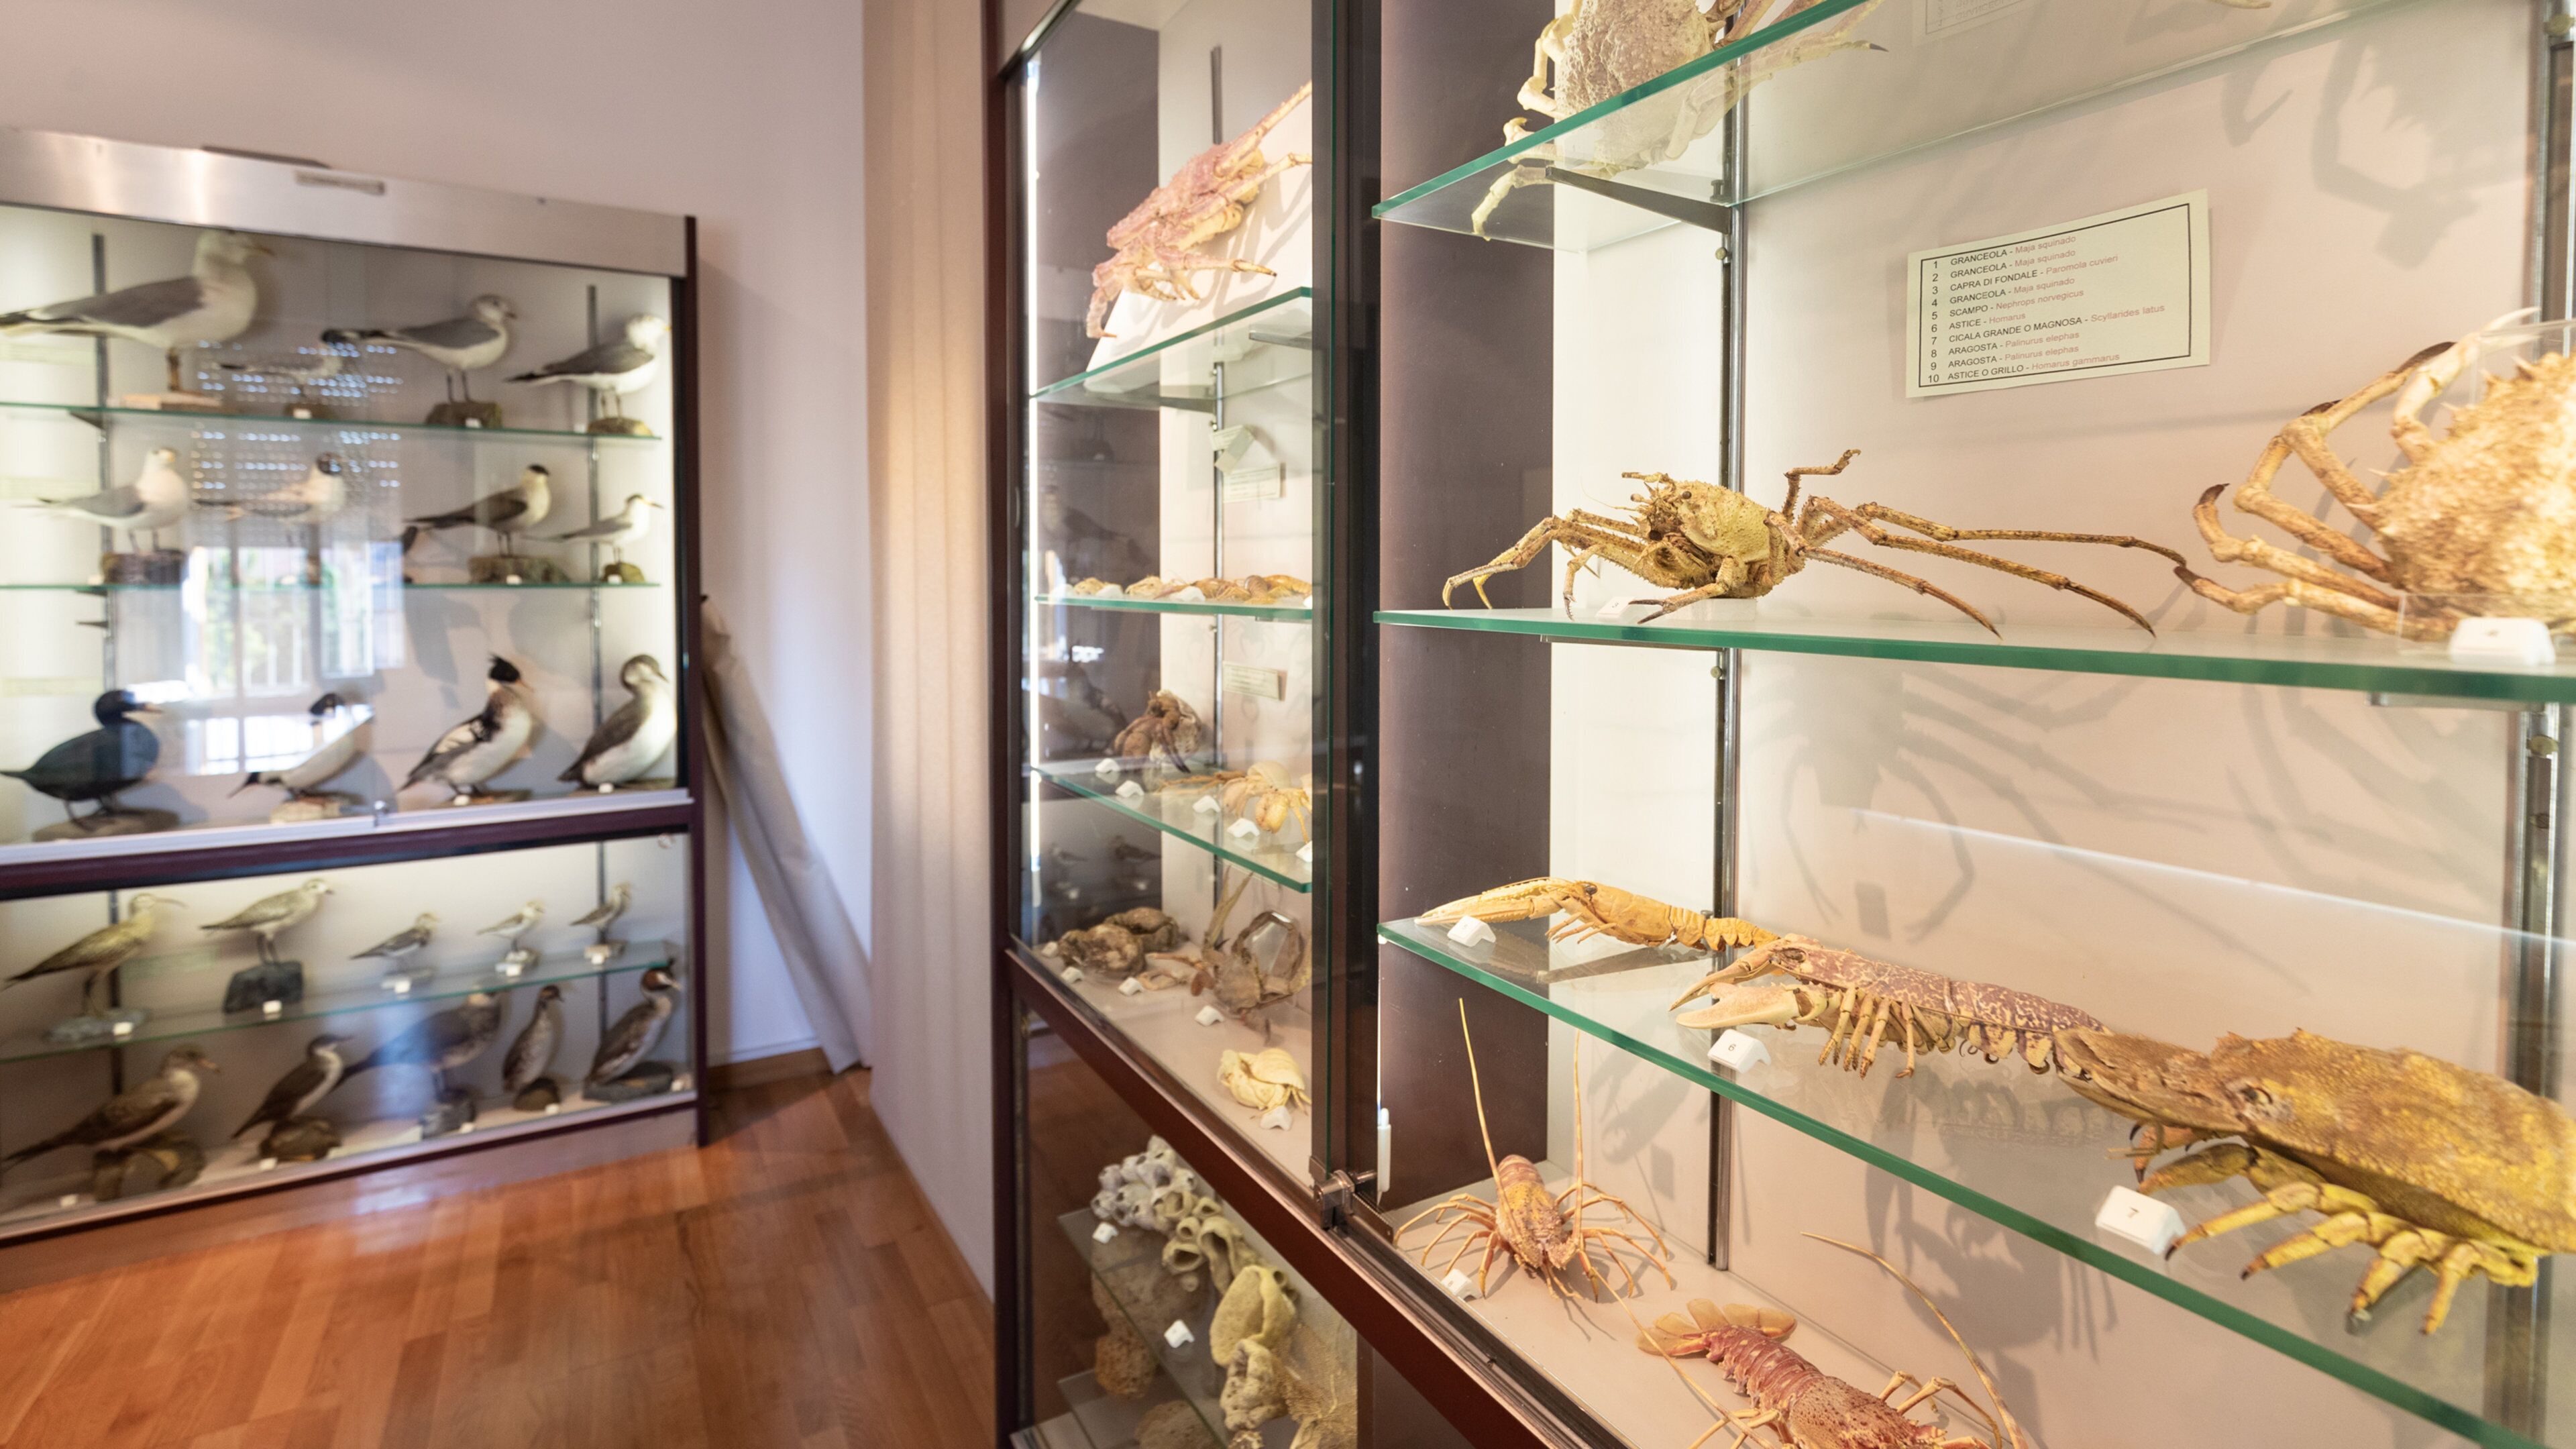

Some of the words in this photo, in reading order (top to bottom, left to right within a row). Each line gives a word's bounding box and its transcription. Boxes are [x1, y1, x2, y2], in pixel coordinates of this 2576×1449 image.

[1950, 250, 2007, 266] GRANCEOLA
[2015, 244, 2035, 254] Maja
[2038, 235, 2076, 249] squinado
[1932, 274, 1938, 282] 2
[1950, 262, 2007, 278] GRANCEOLA
[2015, 258, 2035, 268] Maja
[2037, 250, 2076, 262] squinado
[1932, 286, 1938, 294] 3
[1950, 280, 1981, 291] CAPRA
[1995, 270, 2038, 284] FONDALE
[2046, 261, 2087, 275] Paromola
[2090, 256, 2118, 267] cuvieri
[1931, 299, 1938, 307] 4
[1949, 289, 2006, 304] GRANCEOLA
[2014, 284, 2033, 294] Maja
[2036, 277, 2075, 290] squinado
[1931, 311, 1938, 320] 5
[1949, 305, 1988, 317] SCAMPO
[1996, 298, 2035, 311] Nephrops
[2037, 290, 2084, 302] norvegicus
[1931, 324, 1937, 332] 6
[1949, 319, 1981, 329] ASTICE
[1988, 313, 2026, 325] Homarus
[1931, 337, 1937, 345] 7
[1949, 332, 1981, 343] CICALA
[1983, 325, 2021, 337] GRANDE
[2024, 324, 2031, 332] O
[2033, 317, 2082, 331] MAGNOSA
[2091, 309, 2140, 323] Scyllarides
[2143, 305, 2165, 315] latus
[1931, 350, 1937, 358] 8
[1948, 343, 1998, 356] ARAGOSTA
[2005, 337, 2043, 347] Palinurus
[2046, 332, 2080, 344] elephas
[1931, 362, 1937, 370] 9
[1948, 356, 1997, 368] ARAGOSTA
[2005, 350, 2043, 361] Palinurus
[2045, 345, 2079, 357] elephas
[1928, 374, 1939, 383] 10
[1947, 370, 1979, 380] ASTICE
[1991, 364, 2024, 374] GRILLO
[2032, 360, 2070, 370] Homarus
[2072, 354, 2120, 366] gammarus
